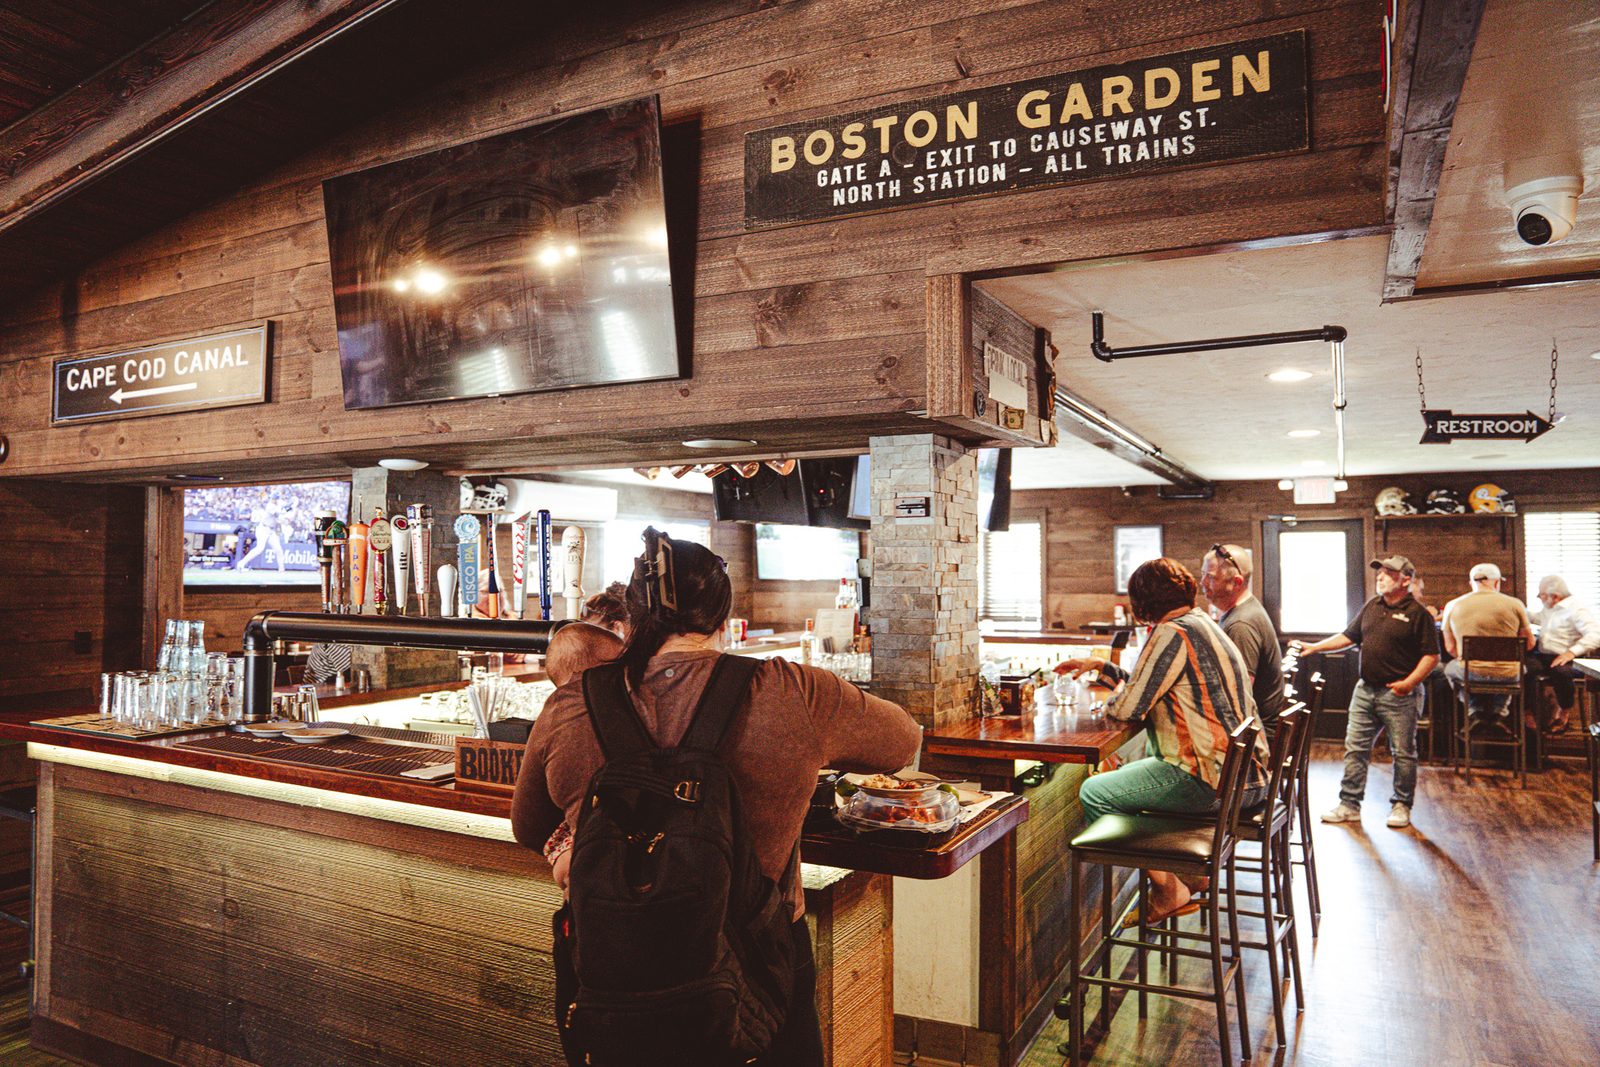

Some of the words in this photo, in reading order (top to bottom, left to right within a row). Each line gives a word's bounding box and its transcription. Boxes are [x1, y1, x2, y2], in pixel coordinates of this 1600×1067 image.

[770, 100, 978, 174] BOSTON
[1016, 50, 1271, 129] GARDEN
[816, 162, 867, 188] GATE
[878, 159, 892, 178] A
[926, 144, 976, 170] EXIT
[988, 137, 1017, 159] TO
[1030, 114, 1163, 153] CAUSEWAY
[1178, 107, 1218, 131] ST.
[833, 179, 901, 207] NORTH
[912, 162, 1007, 194] STATION
[1044, 150, 1088, 175] ALL
[1101, 134, 1196, 166] TRAINS
[66, 365, 117, 392] CAPE
[123, 358, 166, 384] COD
[174, 344, 249, 376] CANAL
[1436, 420, 1538, 434] RESTROOM
[464, 545, 475, 563] IPA
[512, 521, 525, 585] Coors
[465, 566, 476, 602] CISCO
